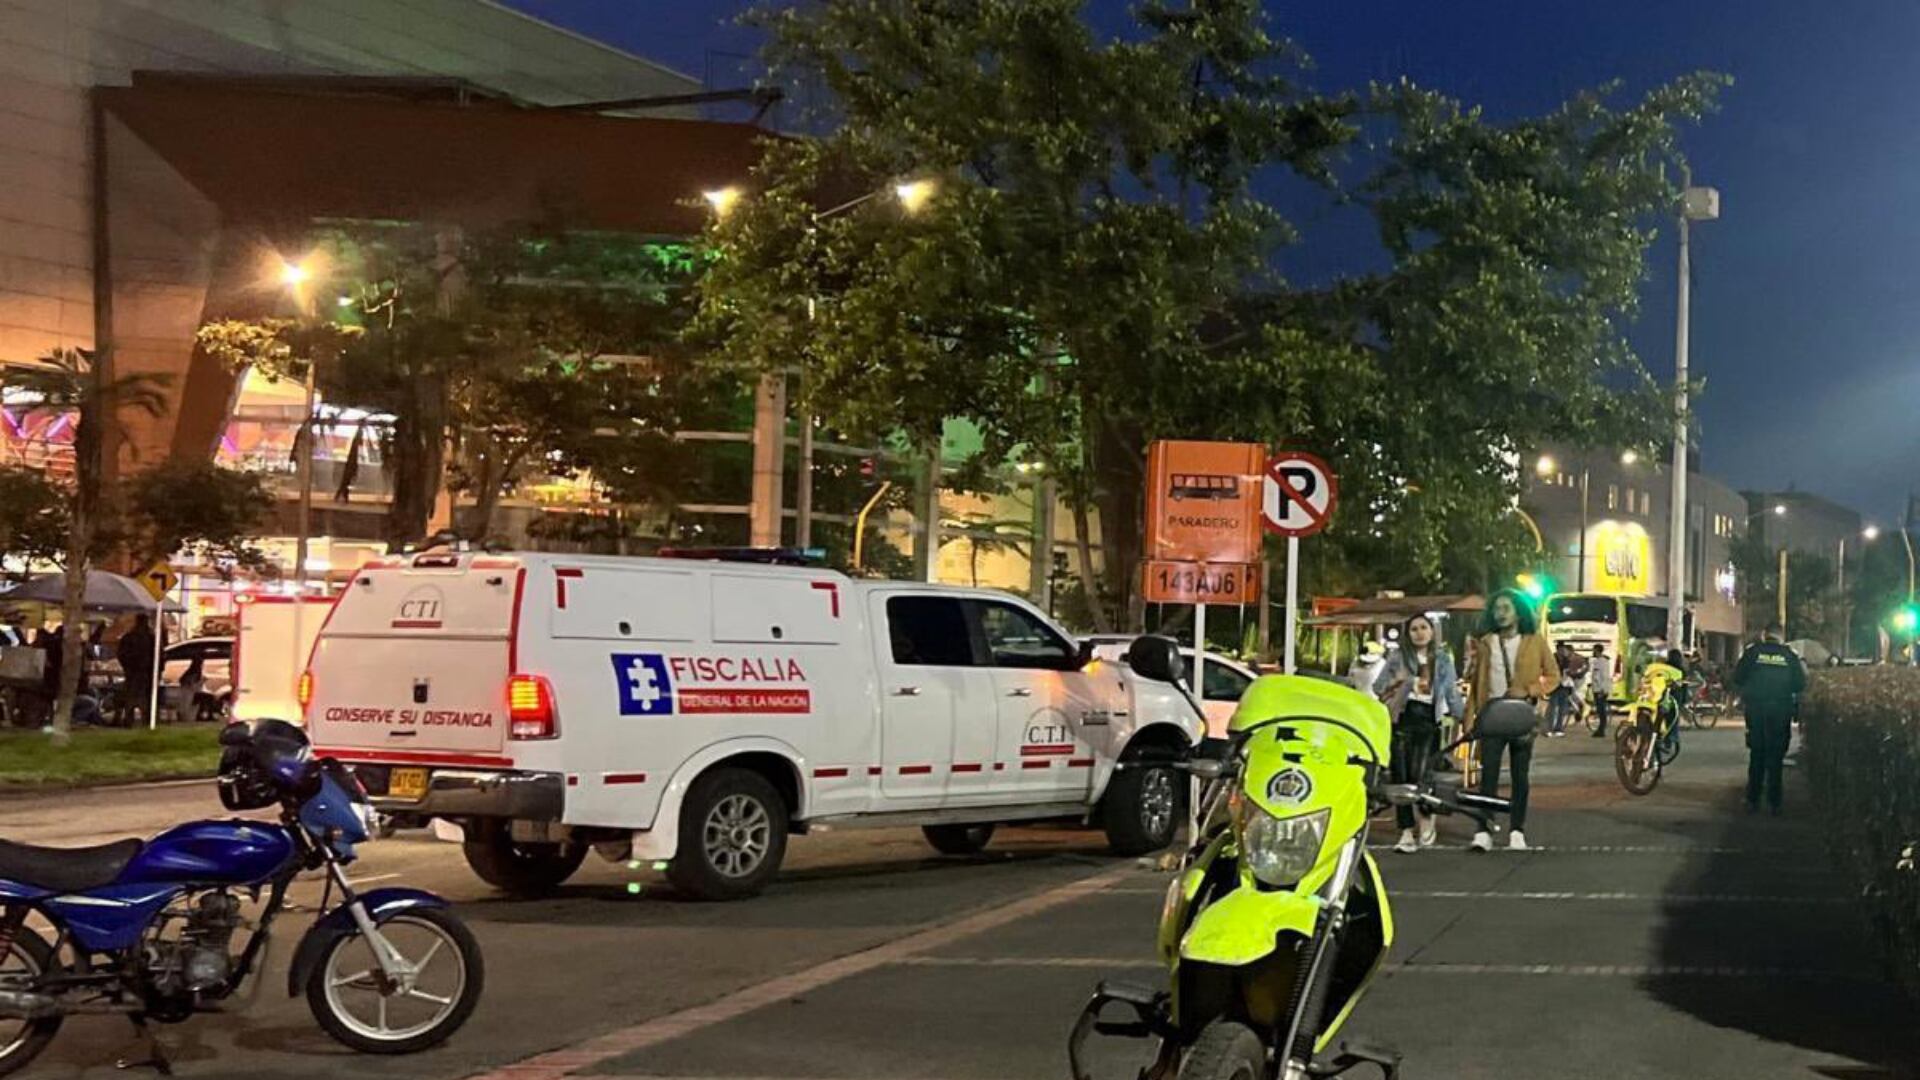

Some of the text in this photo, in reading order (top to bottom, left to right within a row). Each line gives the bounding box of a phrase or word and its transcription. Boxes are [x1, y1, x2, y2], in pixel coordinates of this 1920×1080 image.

[1278, 467, 1316, 520] P
[1168, 515, 1240, 529] PARADERO
[1158, 569, 1235, 594] 143A06
[400, 600, 439, 618] CTI
[669, 657, 806, 682] FISCALIA
[681, 694, 732, 707] GENERAL
[735, 694, 751, 707] DE
[752, 694, 767, 707] LA
[325, 707, 492, 728] CONSERVE SU DISTANCIA
